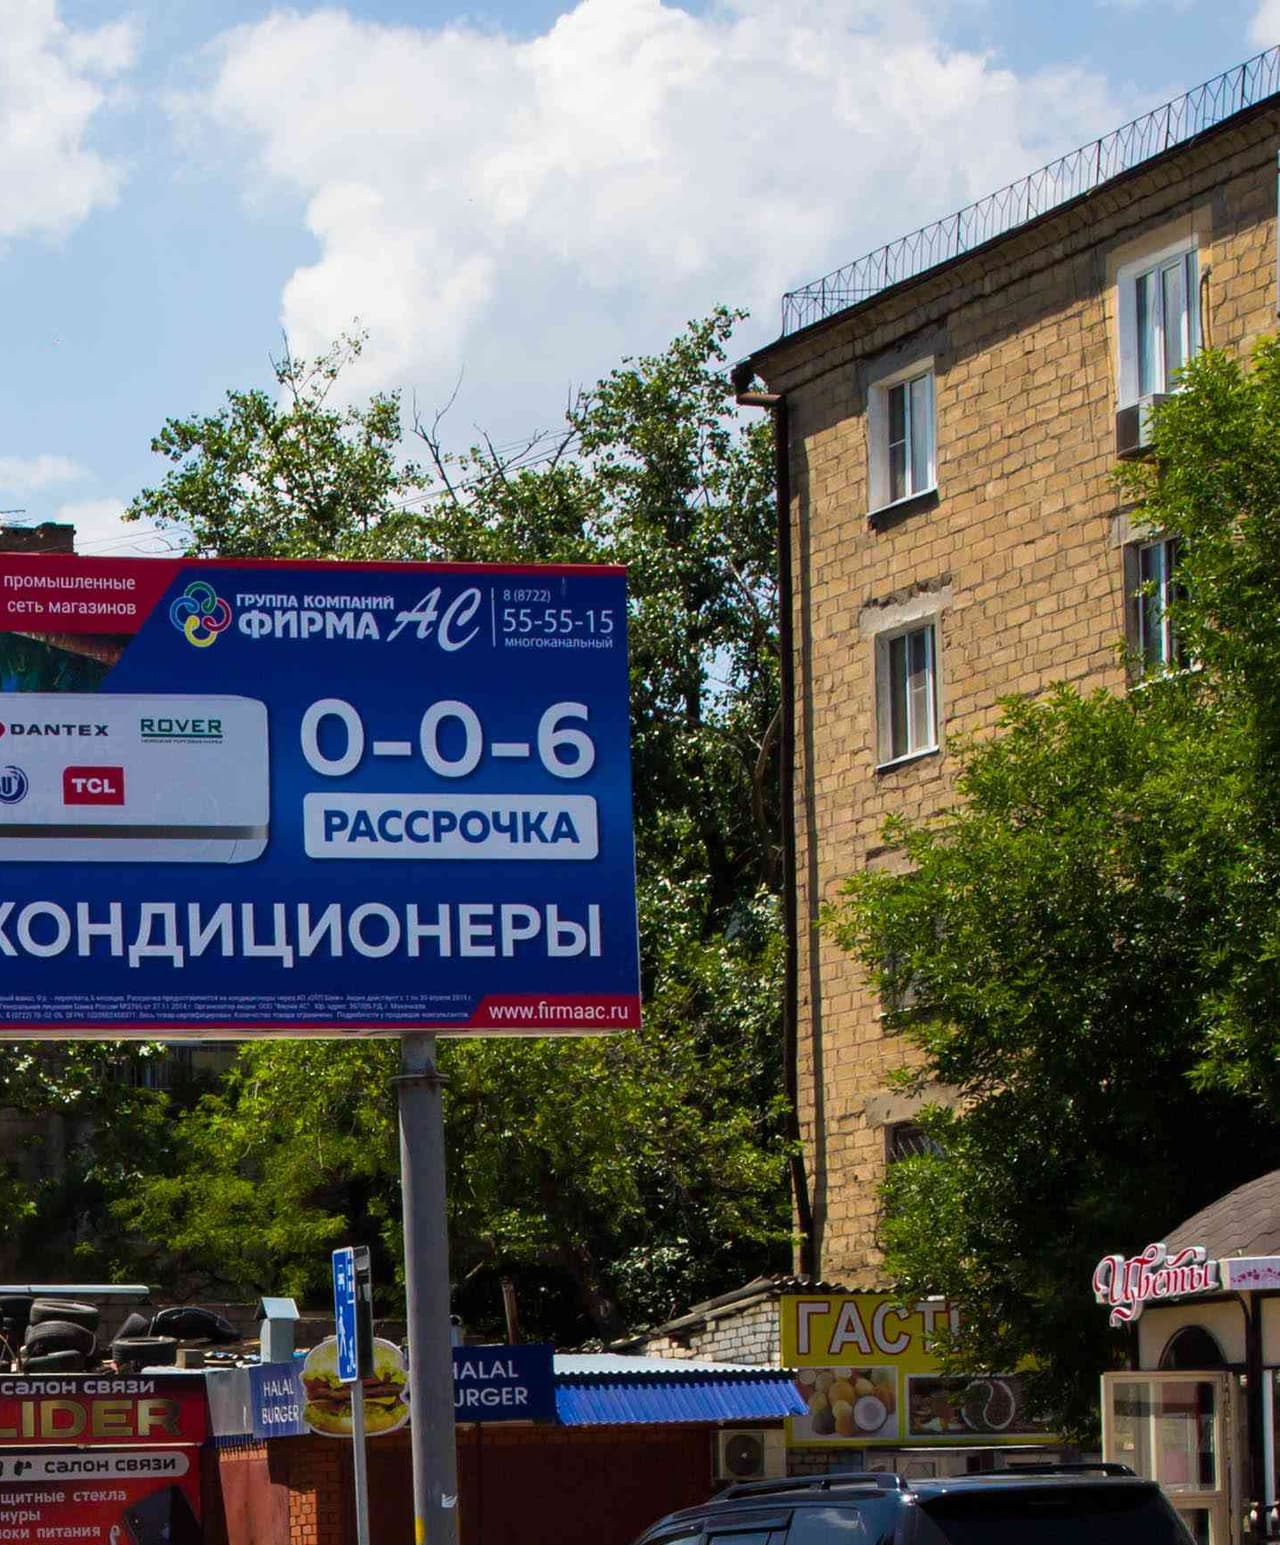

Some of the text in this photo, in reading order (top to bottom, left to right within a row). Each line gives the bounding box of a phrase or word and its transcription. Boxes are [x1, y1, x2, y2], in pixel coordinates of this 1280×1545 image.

[4, 574, 136, 591] промышленные
[236, 592, 395, 610] ГРУППА КОМПАНИЙ
[502, 589, 552, 604] 8 (8722)
[7, 599, 137, 616] сеть магазинов
[238, 609, 380, 640] ФИРМА
[502, 608, 614, 634] 55-55-15
[504, 635, 614, 650] многоканальный
[9, 722, 110, 738] DANTEX
[140, 718, 223, 735] ROVER
[71, 777, 116, 795] TCL
[323, 809, 581, 845] РАССРОЧКА
[488, 1000, 630, 1024] www.firmaac.ru
[1092, 1243, 1219, 1328] Цветы
[796, 1301, 961, 1354] ГАСТ
[0, 1380, 156, 1396] салон связи
[263, 1378, 294, 1397] HALAL
[454, 1387, 528, 1408] URGER
[261, 1404, 300, 1425] BURGER
[44, 1457, 177, 1474] салон связи
[73, 1489, 127, 1502] стекла
[36, 1526, 102, 1539] питания
